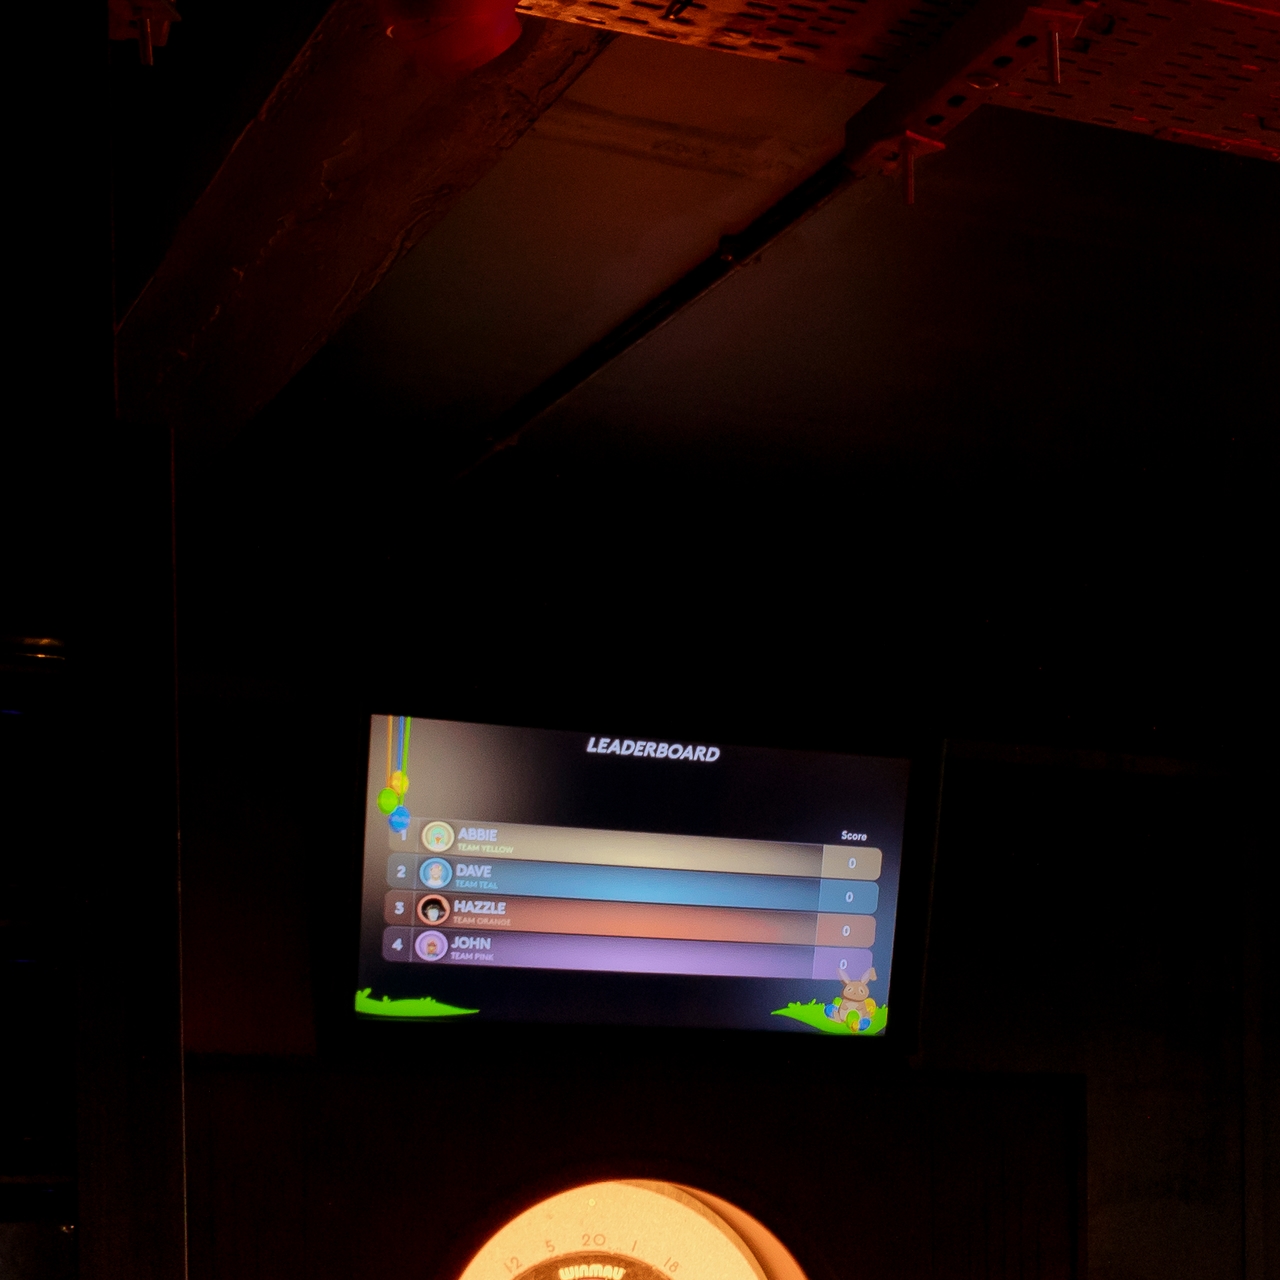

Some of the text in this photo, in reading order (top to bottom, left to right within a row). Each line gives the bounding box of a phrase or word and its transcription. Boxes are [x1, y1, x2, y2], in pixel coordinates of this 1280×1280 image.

[586, 736, 721, 762] LEADERBOARD
[458, 827, 498, 842] ABBIE
[841, 830, 867, 842] Score
[457, 843, 514, 854] TEAM YELLOW
[848, 857, 857, 869] 0
[396, 865, 406, 878] 2
[456, 863, 492, 878] DAVE
[455, 880, 498, 890] TEAM TEAL
[845, 891, 854, 903] 0
[394, 902, 404, 915] 3
[453, 900, 507, 915] HAZZLE
[453, 916, 511, 927] TEAM ORANGE
[842, 925, 851, 937] 0
[392, 938, 403, 951] 4
[451, 936, 492, 950] JOHN
[451, 951, 494, 961] TEAM PINK
[839, 959, 848, 970] 0
[545, 1239, 555, 1253] 5
[581, 1233, 606, 1247] 20
[632, 1240, 638, 1252] 1
[503, 1256, 522, 1273] 12
[663, 1257, 680, 1273] 18
[559, 1264, 624, 1280] WINMAU
